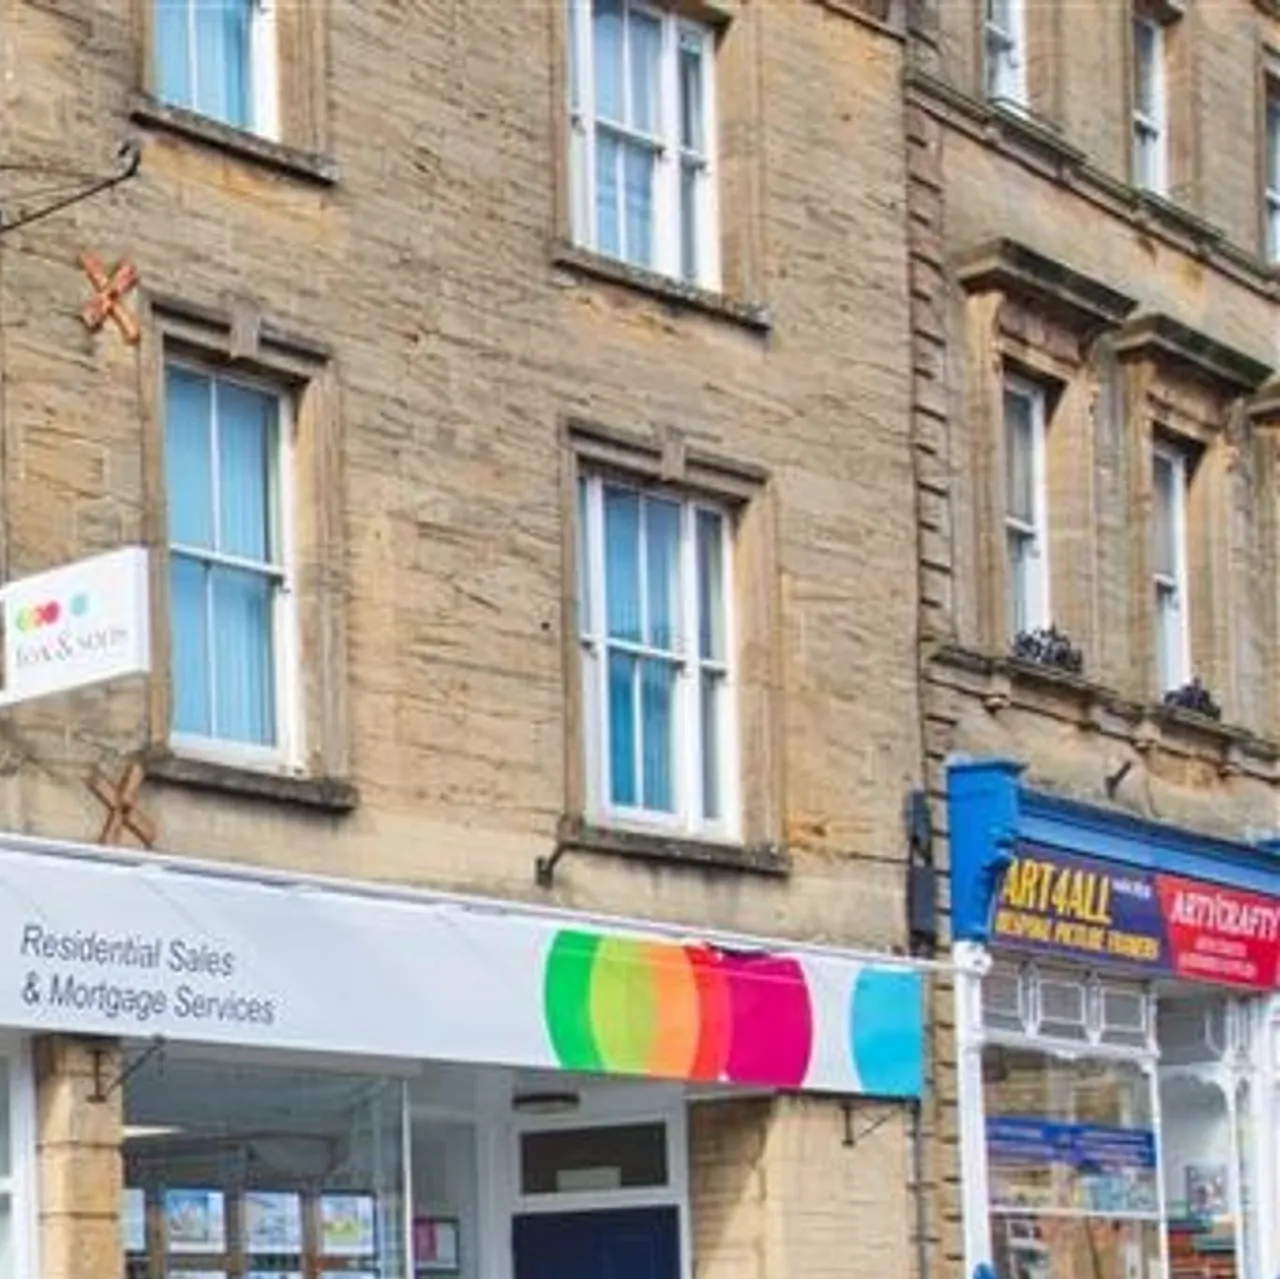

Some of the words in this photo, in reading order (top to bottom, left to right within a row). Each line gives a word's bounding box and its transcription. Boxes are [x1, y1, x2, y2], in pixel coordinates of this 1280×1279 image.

[1003, 858, 1112, 925] ART4ALL
[21, 926, 162, 968] Residential
[169, 941, 236, 976] Sales
[21, 973, 40, 1005] &
[49, 976, 168, 1020] Mortgage
[174, 987, 274, 1024] Services
